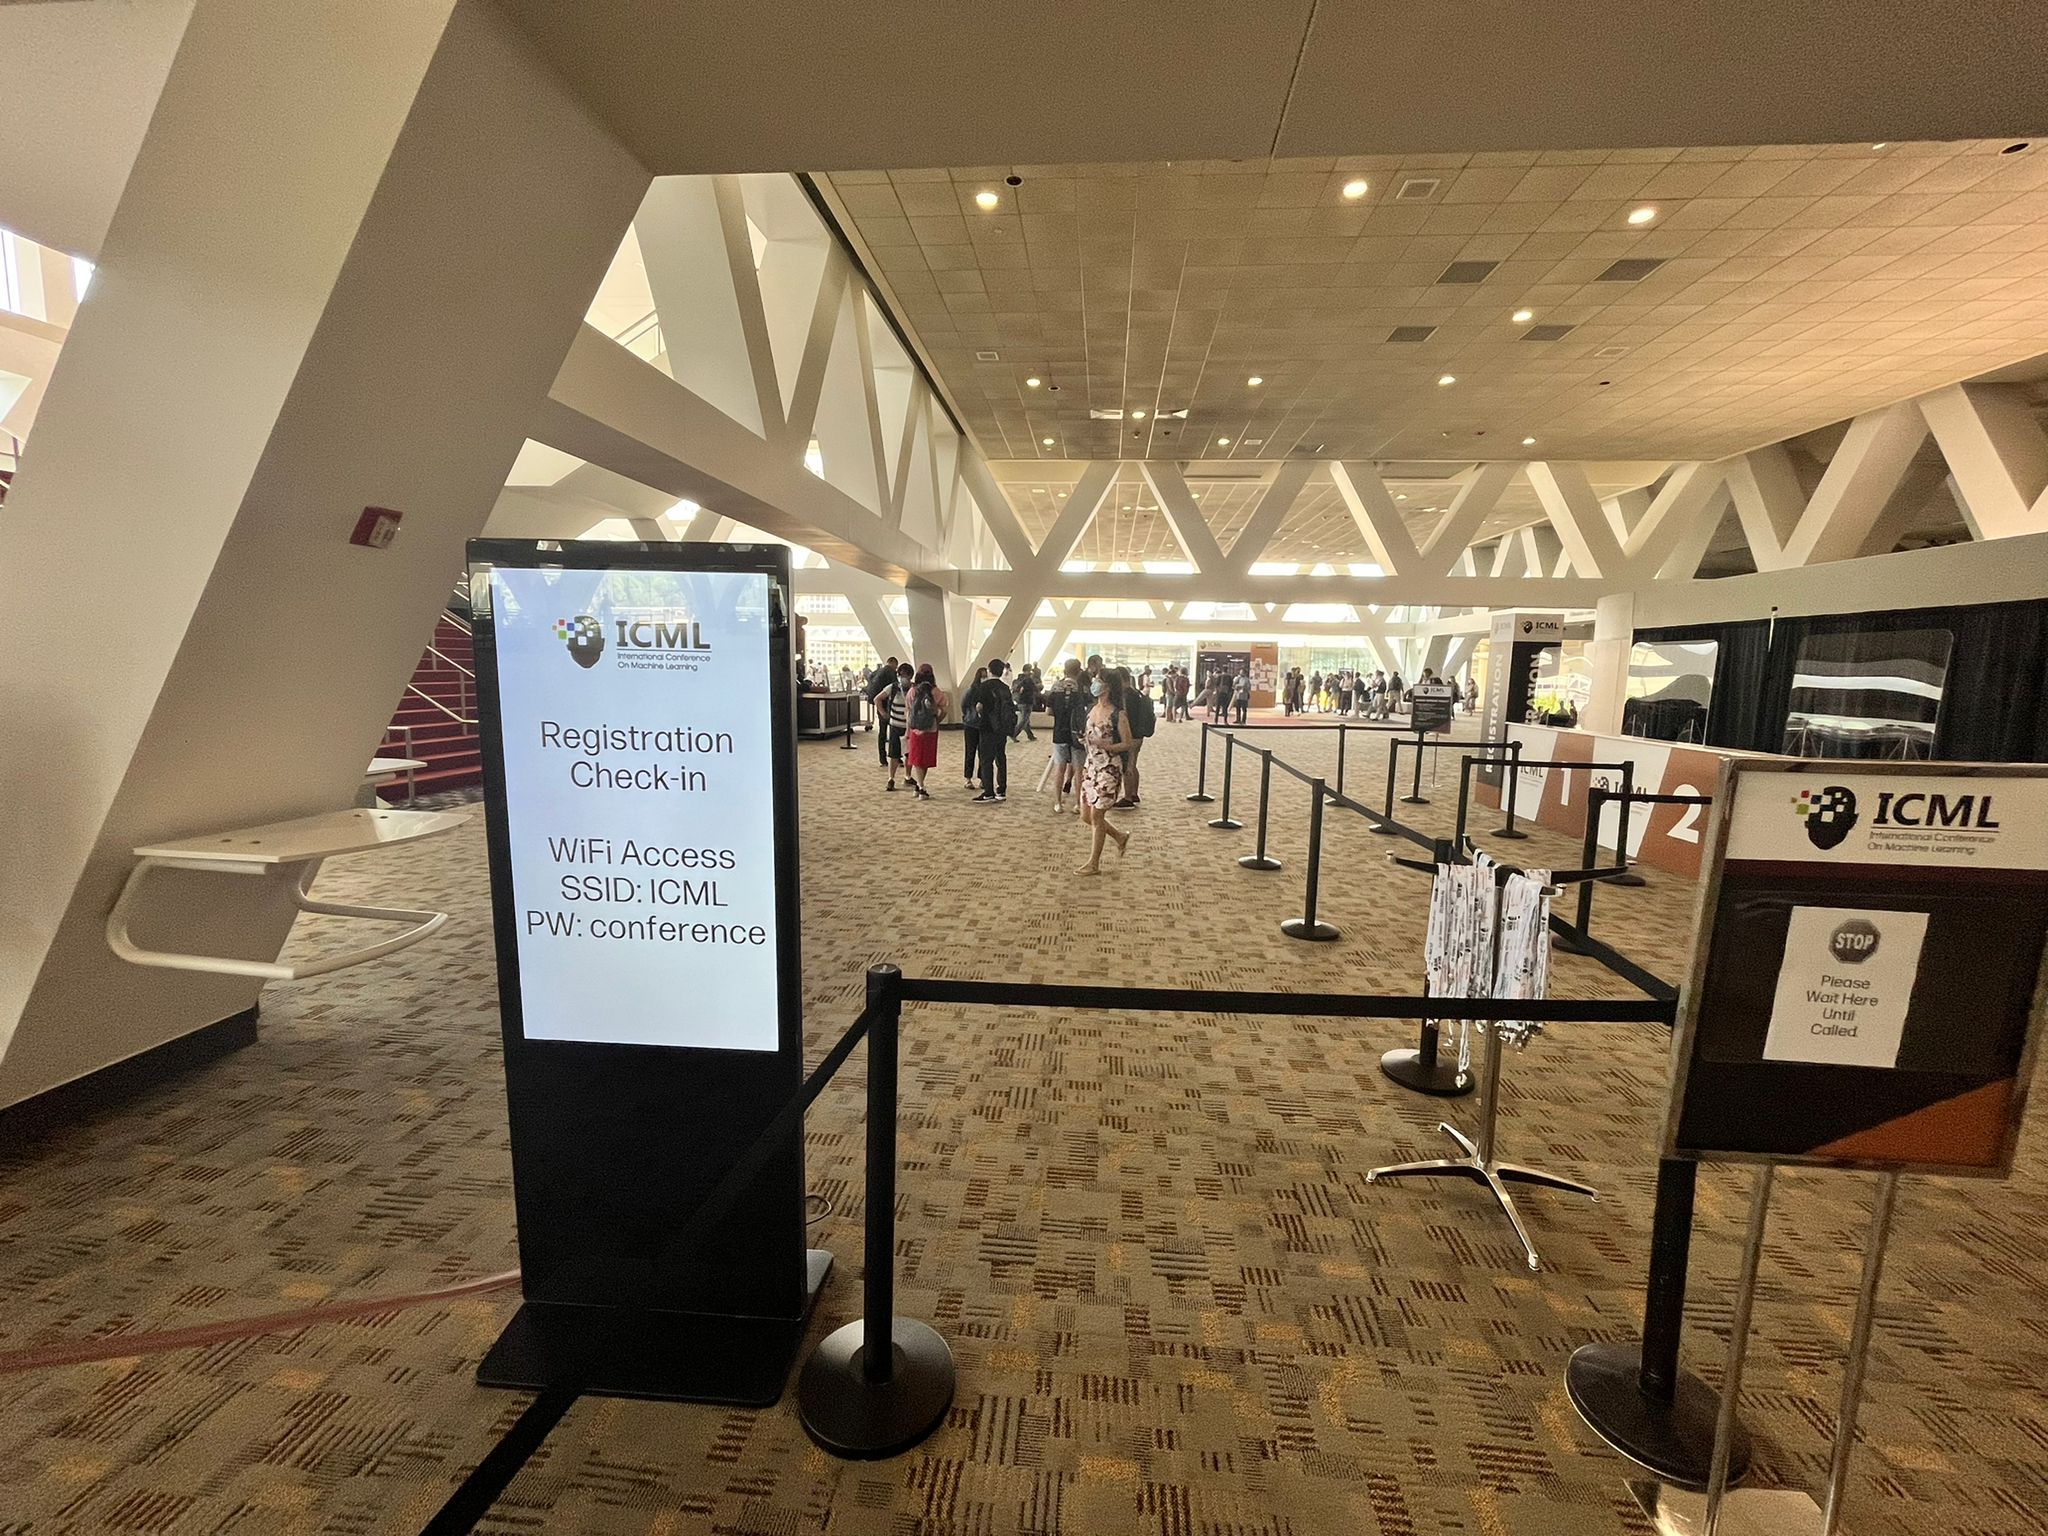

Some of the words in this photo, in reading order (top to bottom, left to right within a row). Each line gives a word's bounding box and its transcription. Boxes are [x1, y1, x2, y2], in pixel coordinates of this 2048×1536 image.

[616, 620, 711, 649] ICML
[1535, 621, 1560, 631] ICML
[617, 652, 664, 661] International
[665, 653, 711, 662] Conference
[617, 661, 629, 669] On
[630, 662, 664, 670] Machine
[665, 663, 698, 672] Learning
[540, 721, 734, 756] Registration
[570, 761, 707, 792] Check-in
[1560, 761, 1572, 807] 1
[1666, 783, 1703, 845] 2
[1873, 792, 2000, 828] ICML
[548, 837, 612, 864] WiFi
[620, 839, 736, 869] Access
[560, 874, 643, 903] SSID:
[650, 878, 729, 907] ICML
[526, 910, 582, 938] PW:
[589, 915, 766, 945] conference
[1835, 932, 1875, 951] STOP
[1820, 974, 1871, 990] Please
[1806, 990, 1839, 1005] Wait
[1842, 992, 1879, 1008] Here
[1822, 1007, 1856, 1022] Until
[1810, 1023, 1858, 1038] Called
